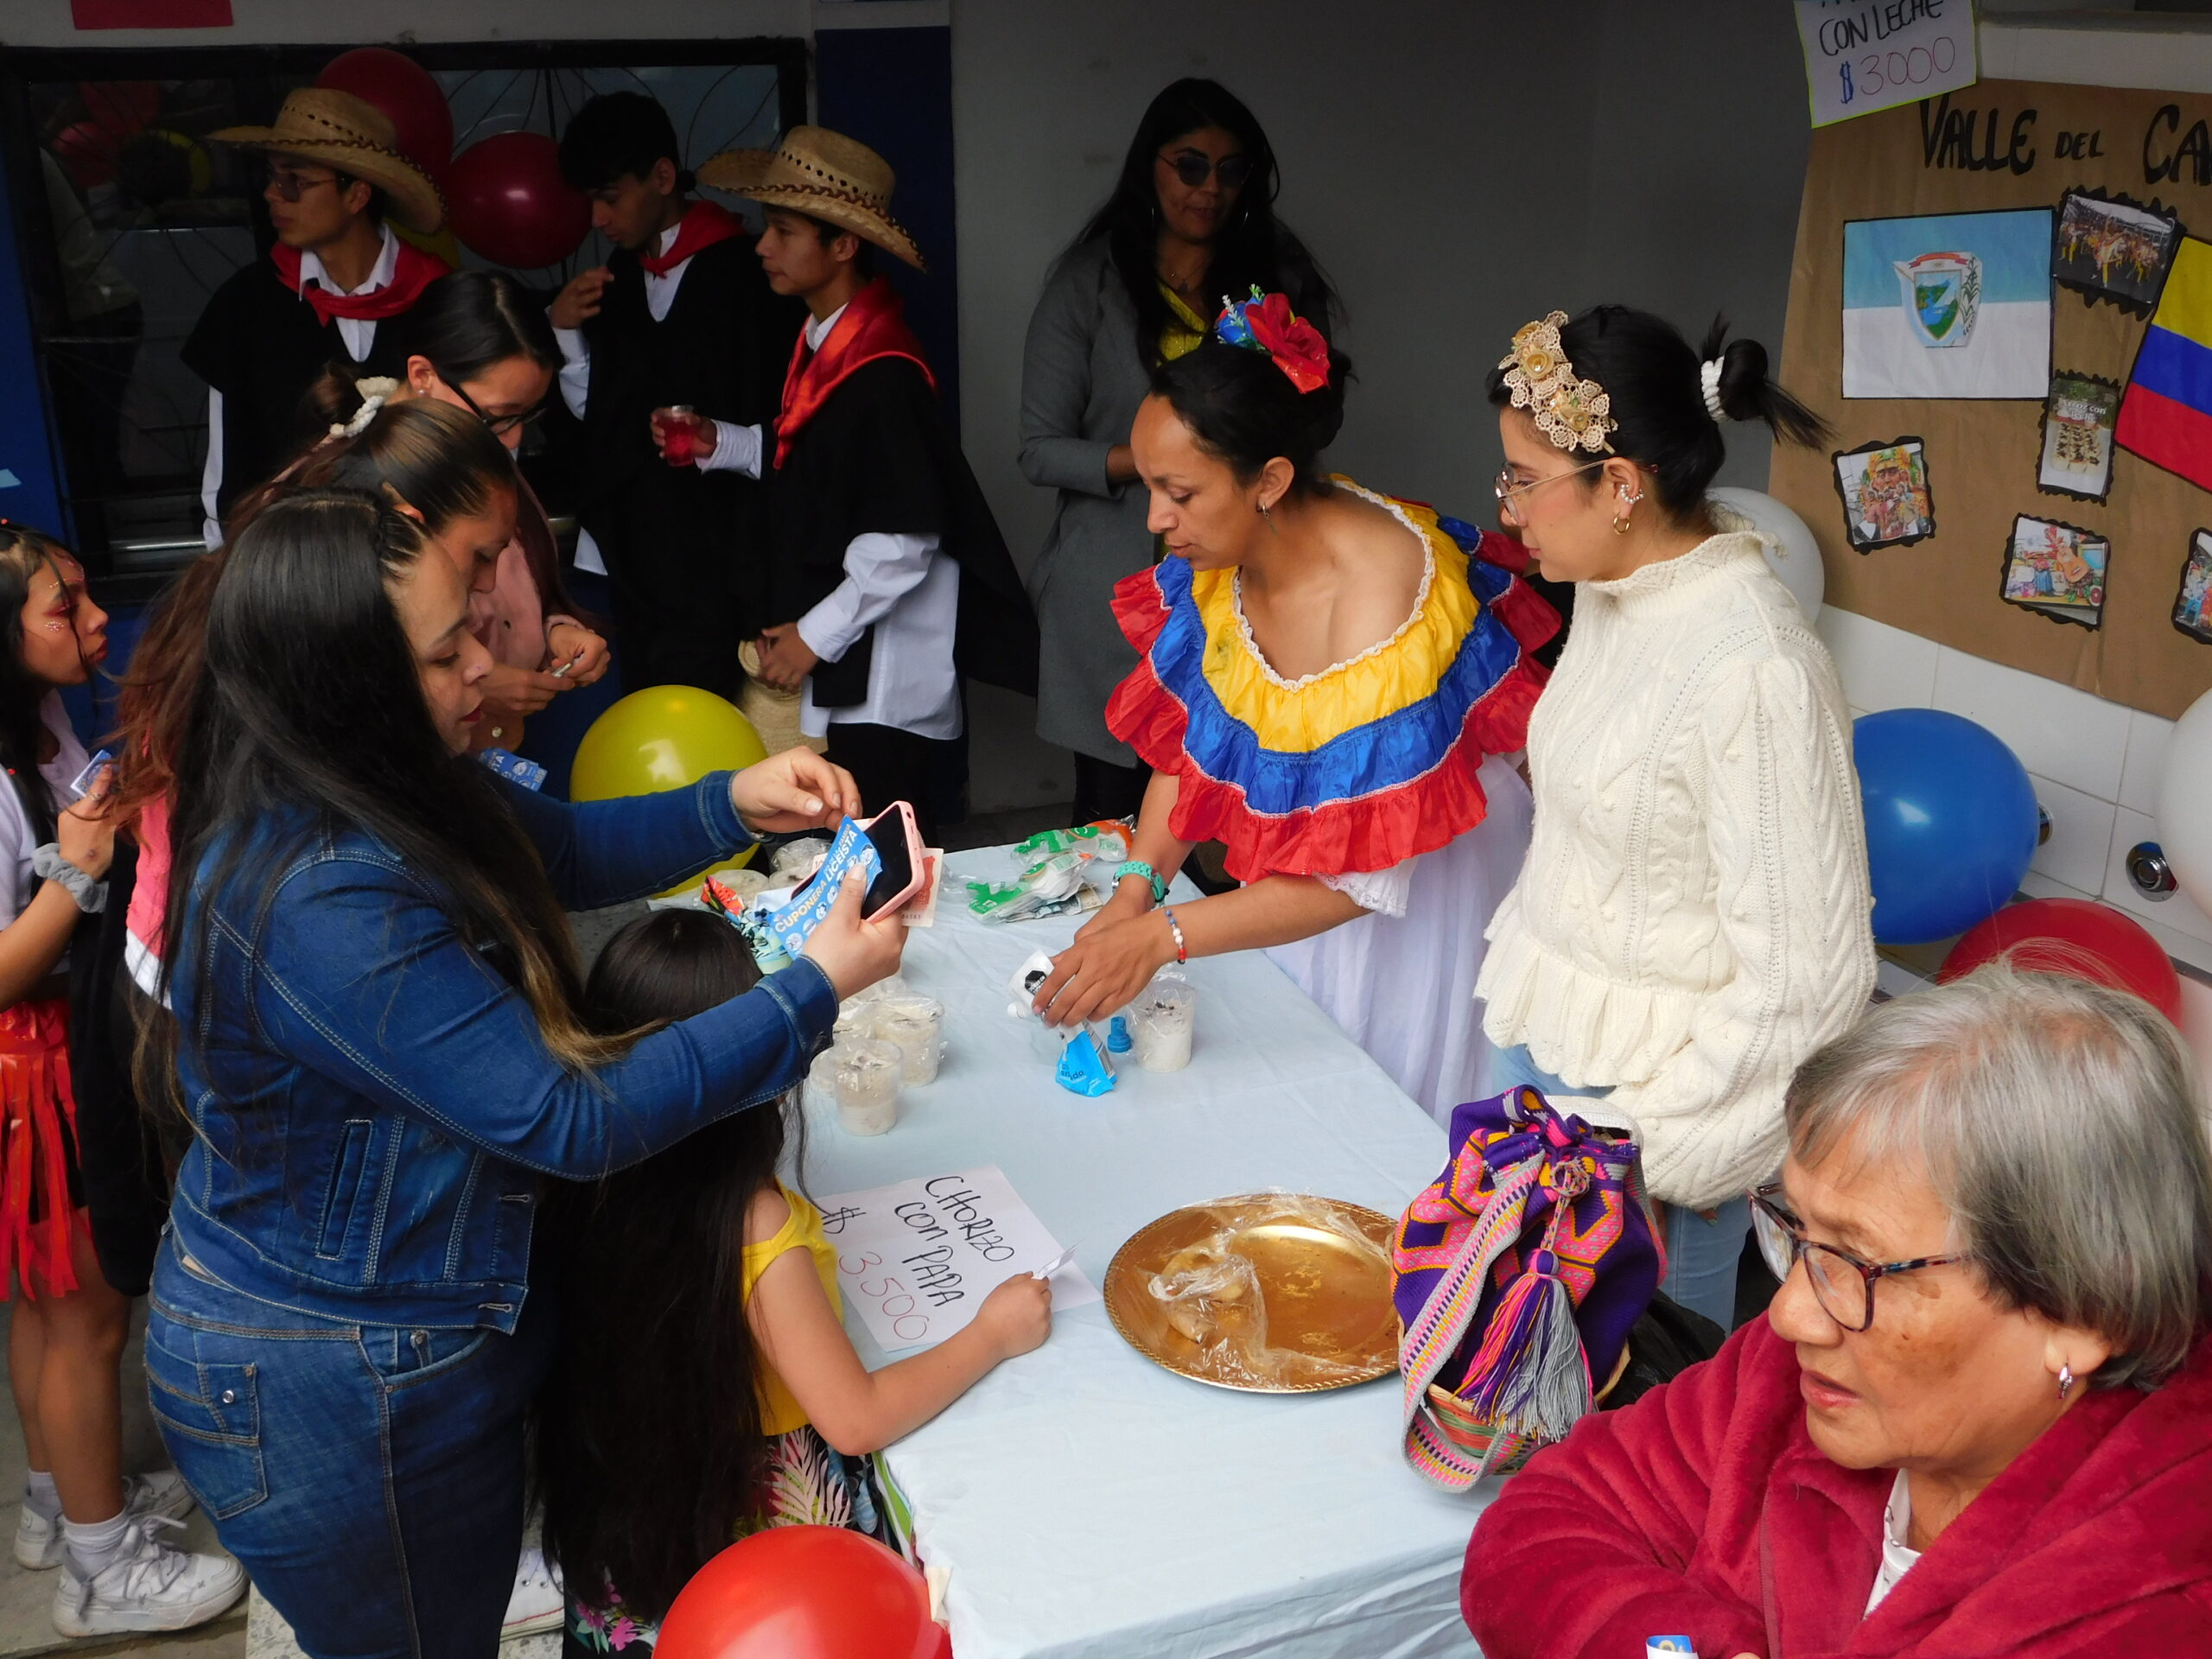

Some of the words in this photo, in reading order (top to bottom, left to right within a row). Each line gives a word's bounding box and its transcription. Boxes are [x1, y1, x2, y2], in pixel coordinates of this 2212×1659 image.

[1819, 12, 1869, 56] CON
[1872, 0, 1945, 40] LECHE
[1919, 92, 2037, 175] VALLE
[2055, 130, 2105, 160] DEL
[2144, 105, 2212, 187] CA
[774, 880, 828, 933] CUPONERA
[925, 1175, 1015, 1262] CHORIZO
[901, 1244, 965, 1307] PAPA
